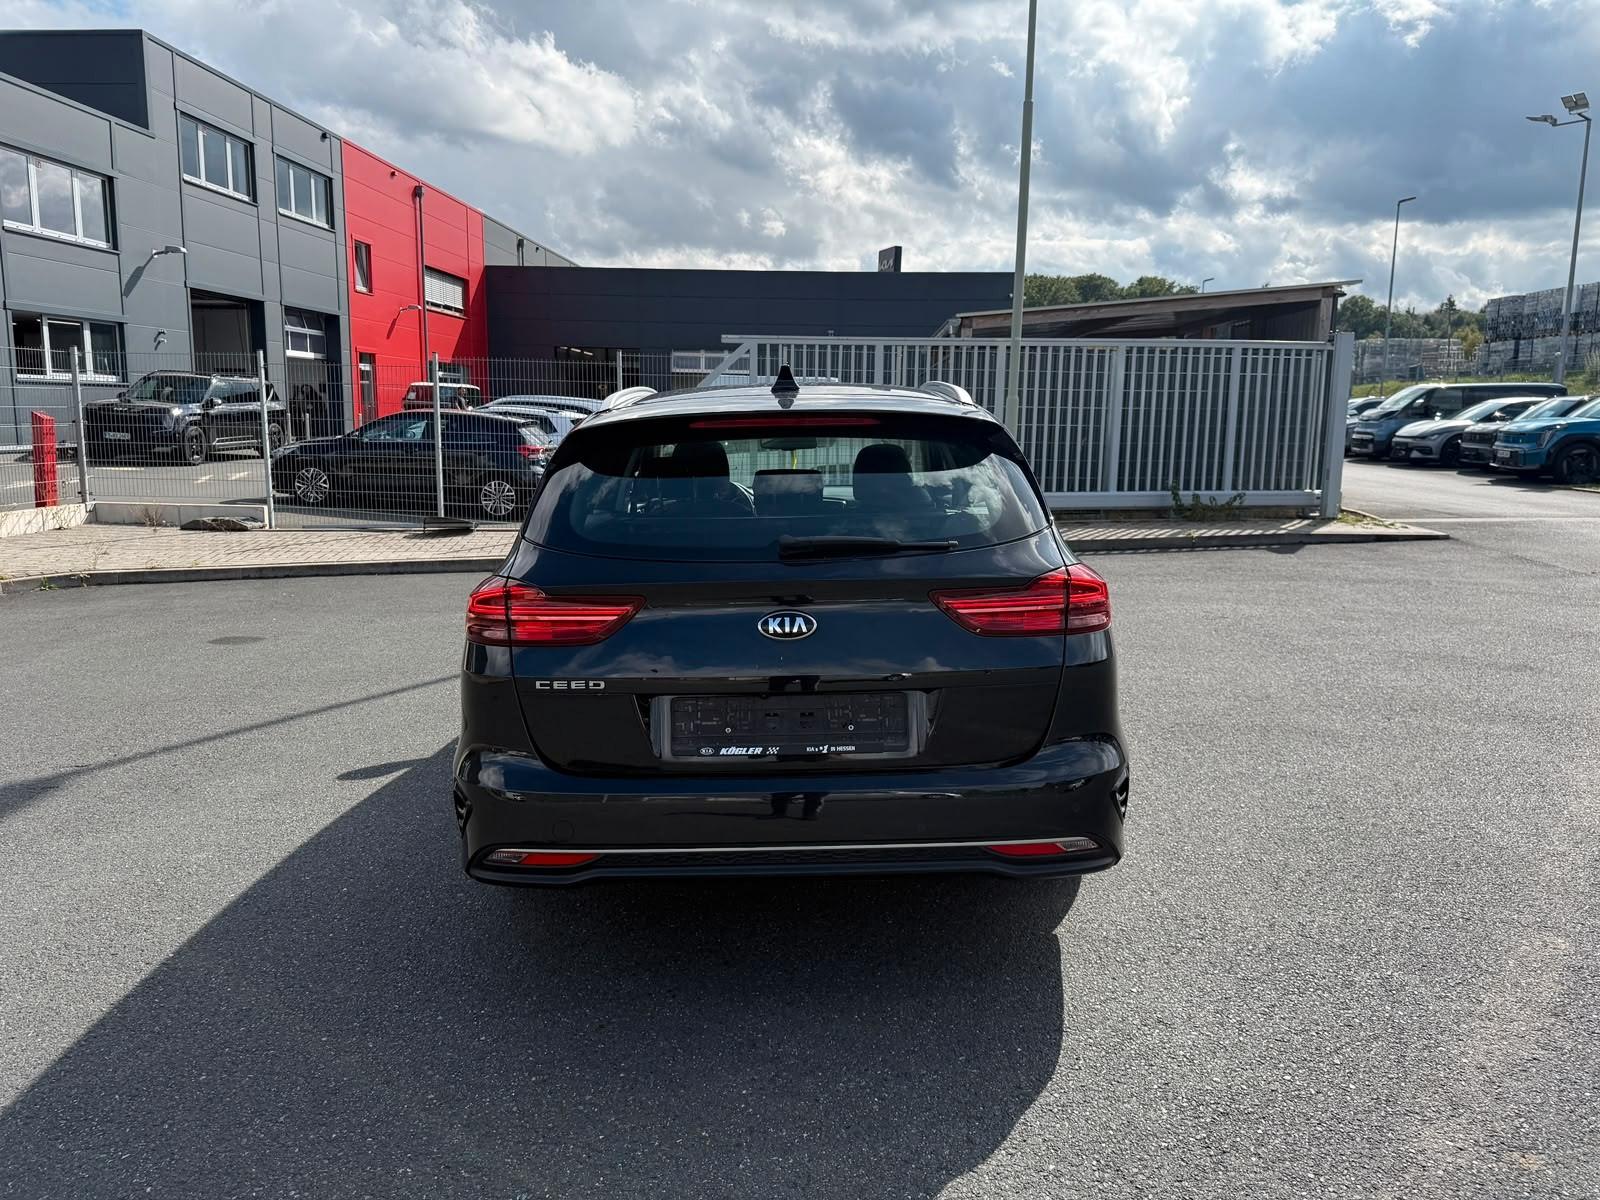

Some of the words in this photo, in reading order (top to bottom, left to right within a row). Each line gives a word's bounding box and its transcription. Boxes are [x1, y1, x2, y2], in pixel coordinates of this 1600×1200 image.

[767, 617, 808, 634] KIA
[535, 680, 605, 690] CEED
[720, 746, 763, 755] KÖGLER
